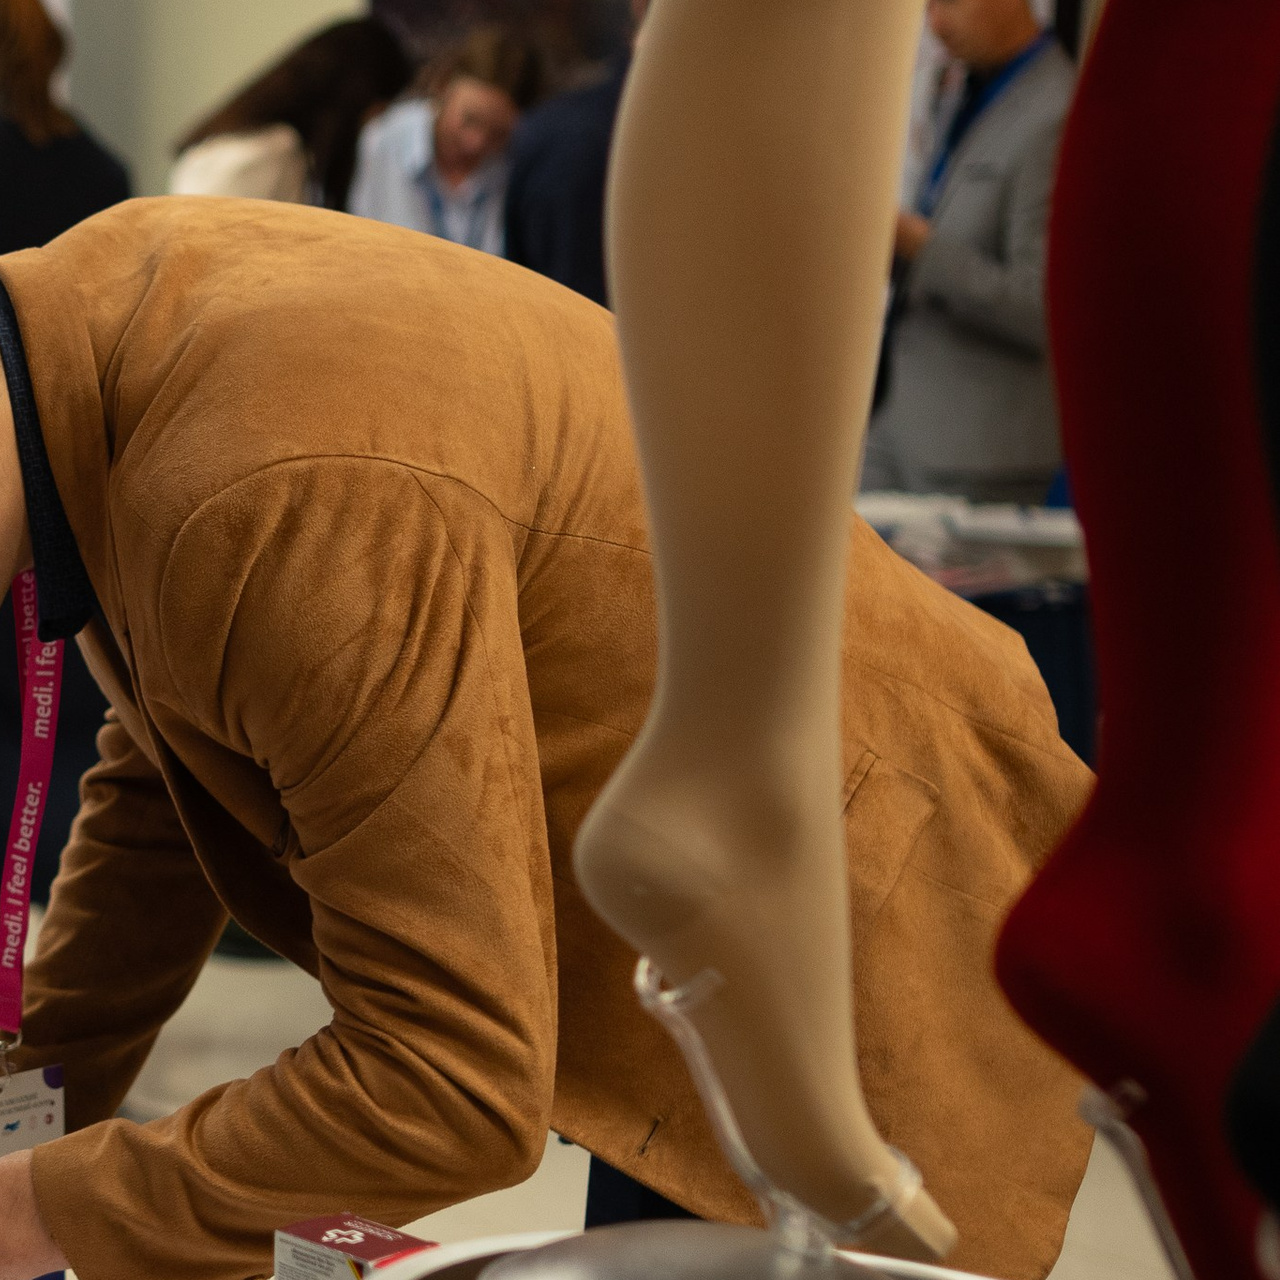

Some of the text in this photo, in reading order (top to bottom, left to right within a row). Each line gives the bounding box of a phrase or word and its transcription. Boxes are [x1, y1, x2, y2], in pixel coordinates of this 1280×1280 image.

[22, 571, 35, 631] bette
[32, 680, 55, 739] medi.
[12, 780, 43, 853] better.
[6, 852, 29, 896] feel
[1, 908, 24, 969] medi.
